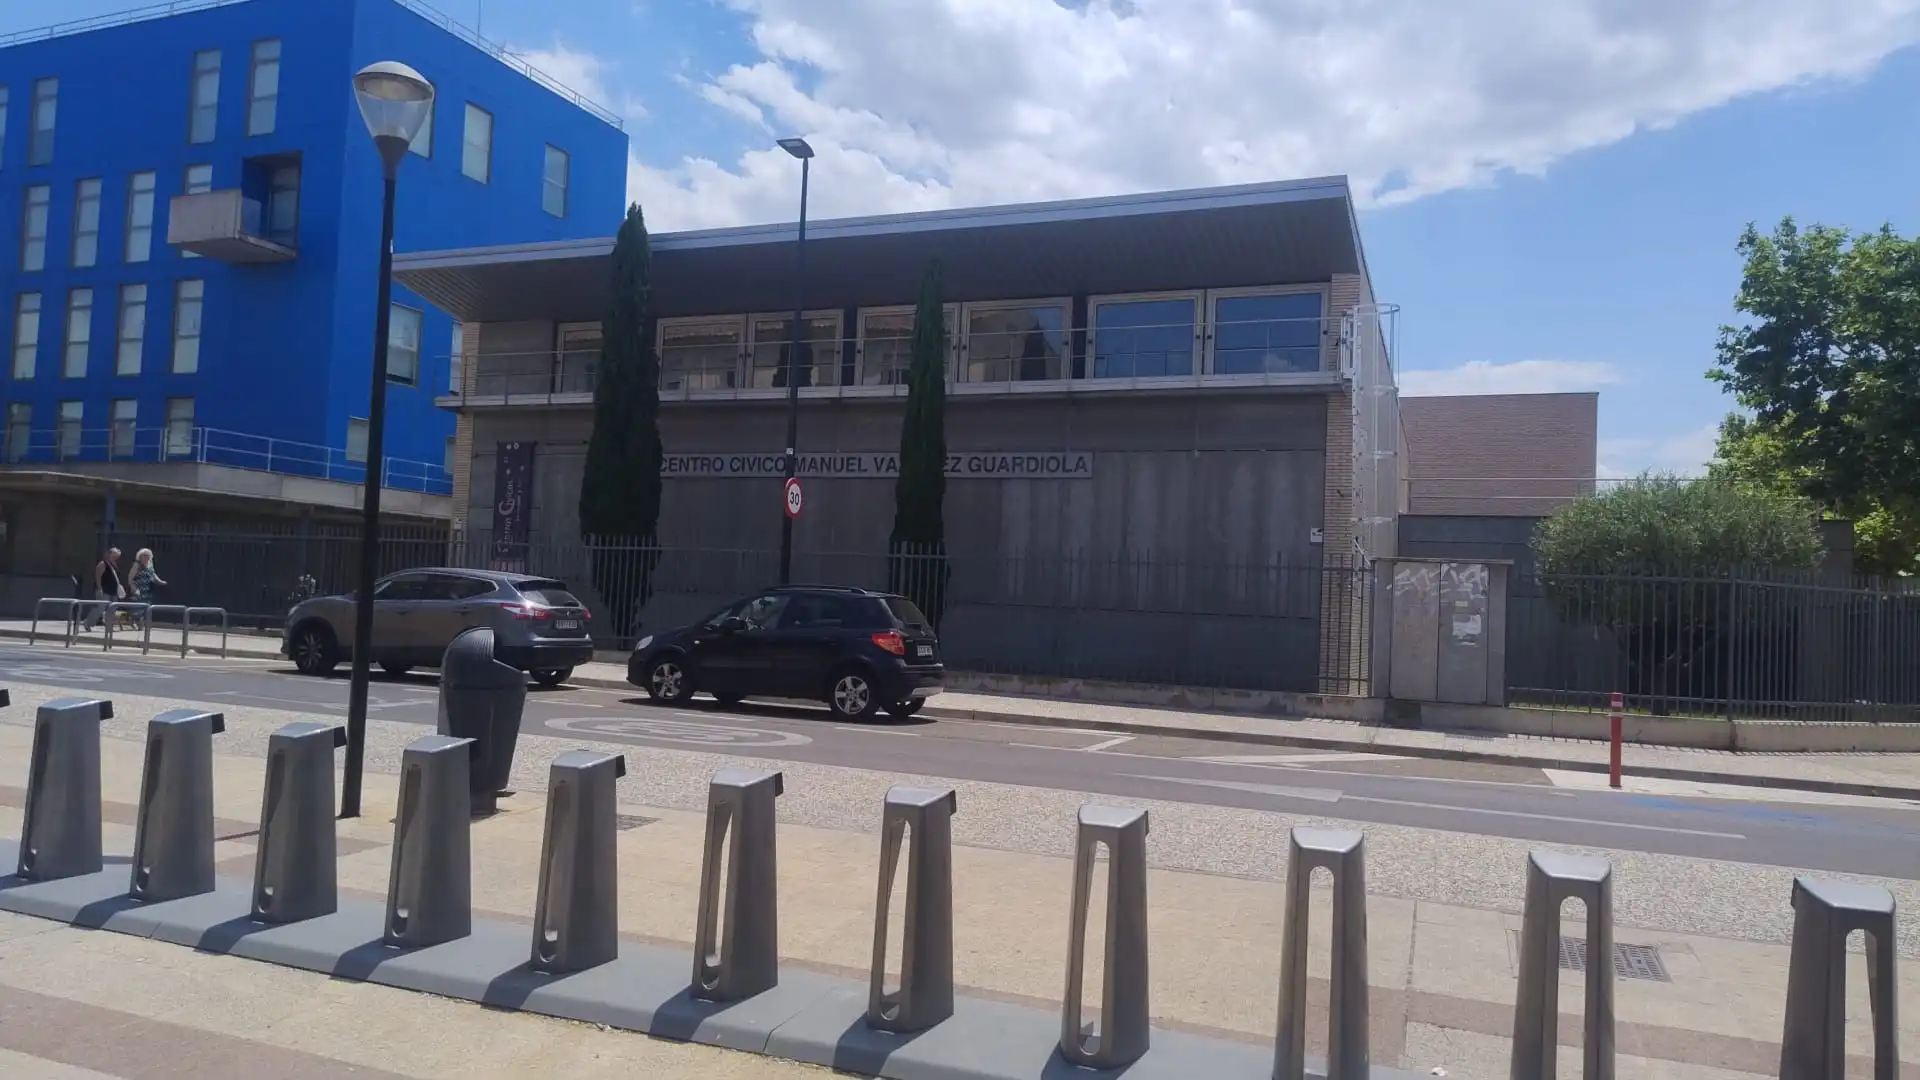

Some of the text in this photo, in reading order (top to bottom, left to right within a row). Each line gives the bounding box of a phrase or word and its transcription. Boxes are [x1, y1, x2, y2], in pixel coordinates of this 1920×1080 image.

[659, 455, 1088, 473] CENTRO CIVICO MANUEL VAEZ GUARDIOLA
[790, 491, 800, 506] 30
